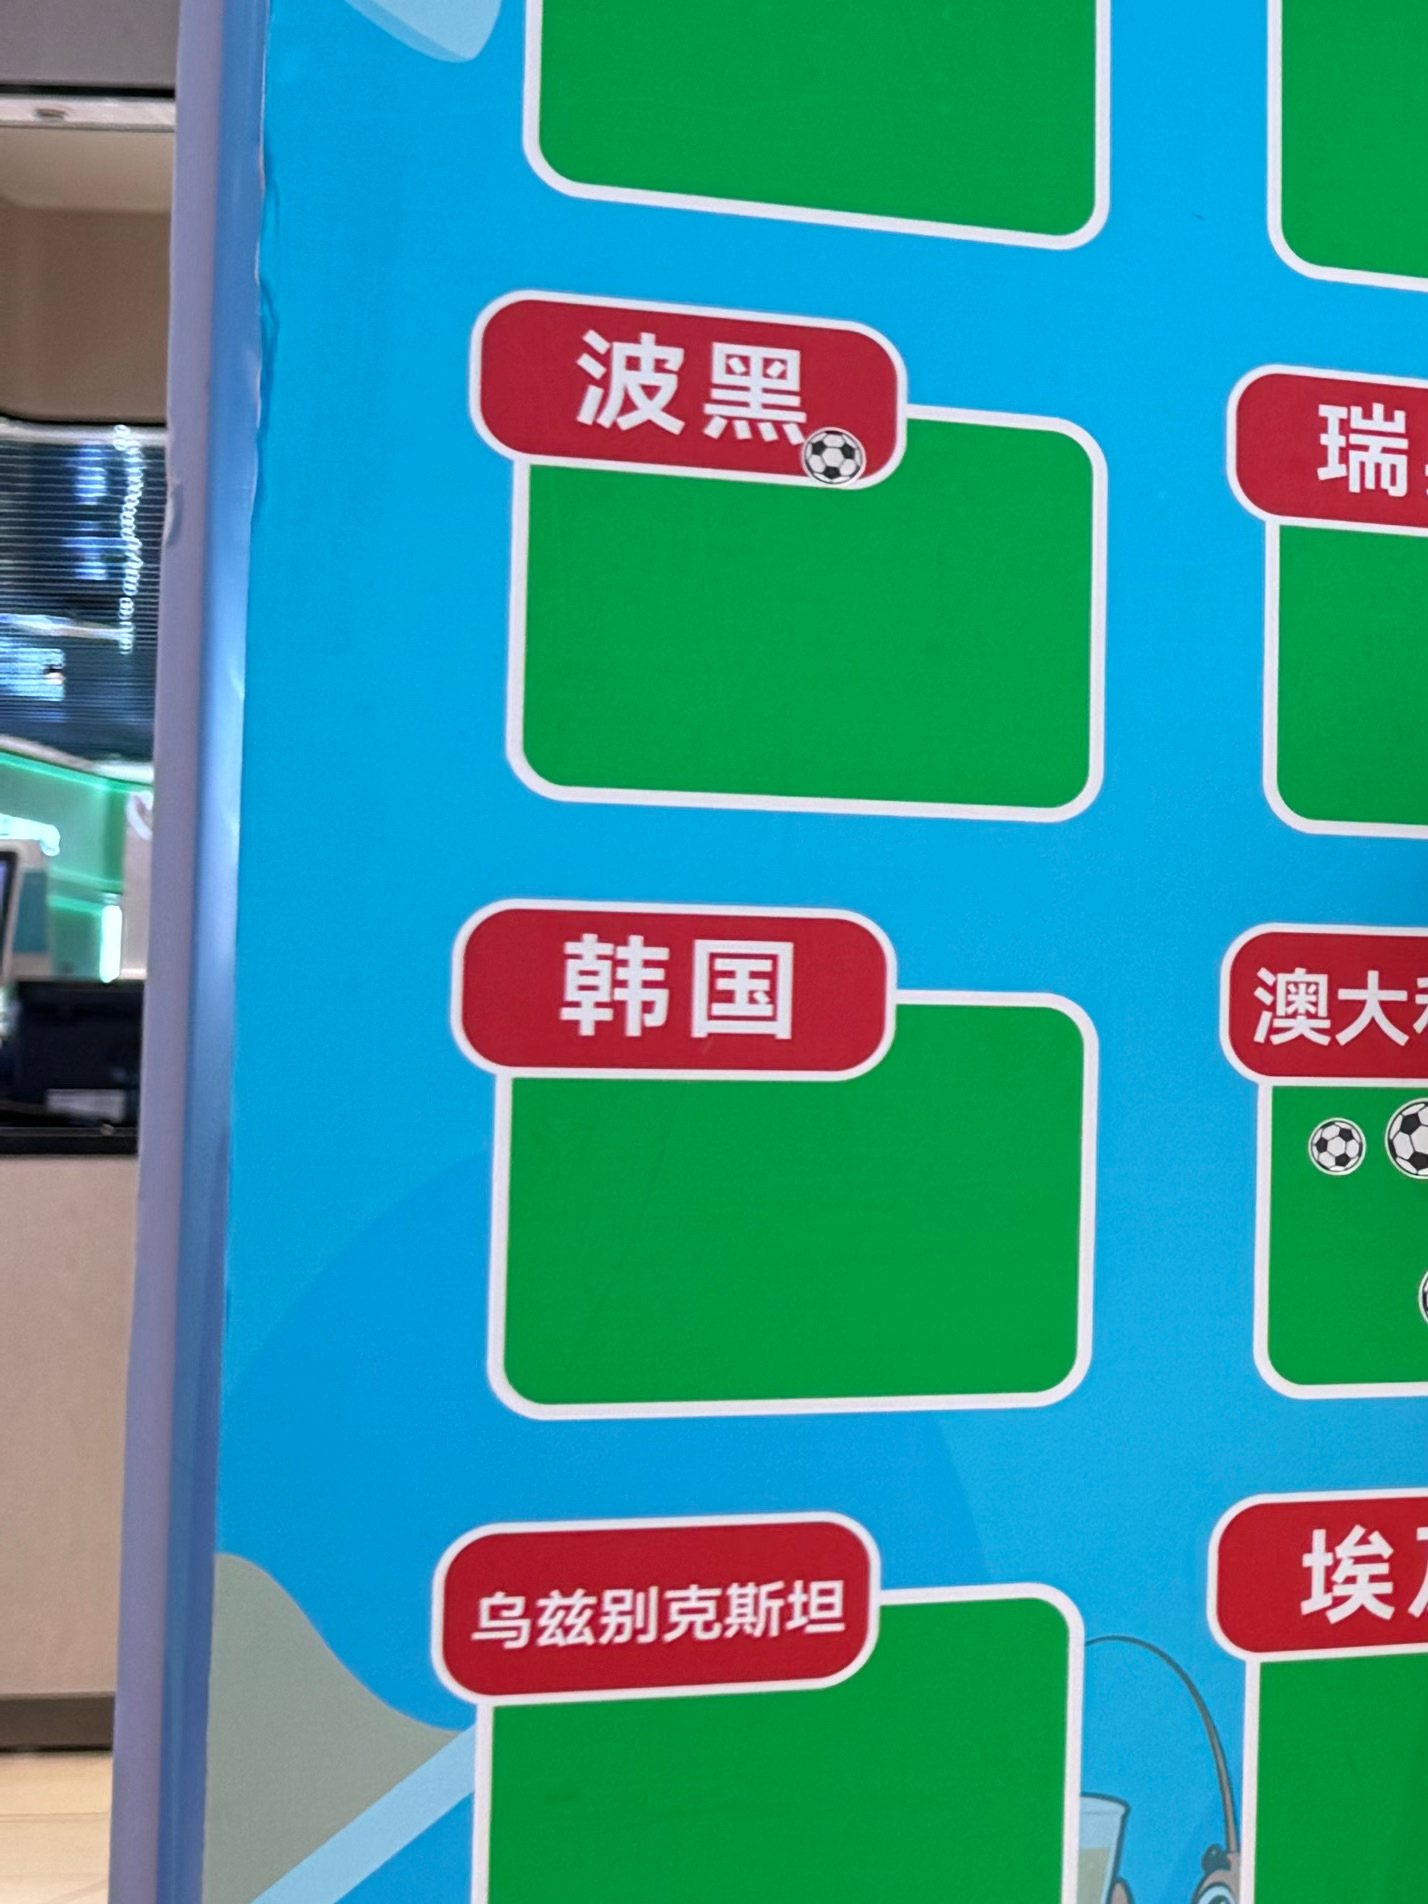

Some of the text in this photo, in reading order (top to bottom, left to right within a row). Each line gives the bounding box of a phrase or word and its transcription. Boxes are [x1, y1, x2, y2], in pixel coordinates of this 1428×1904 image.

[577, 330, 810, 448] 波黑
[560, 934, 793, 1039] 韩国
[472, 1580, 845, 1648] 乌兹别克斯坦
